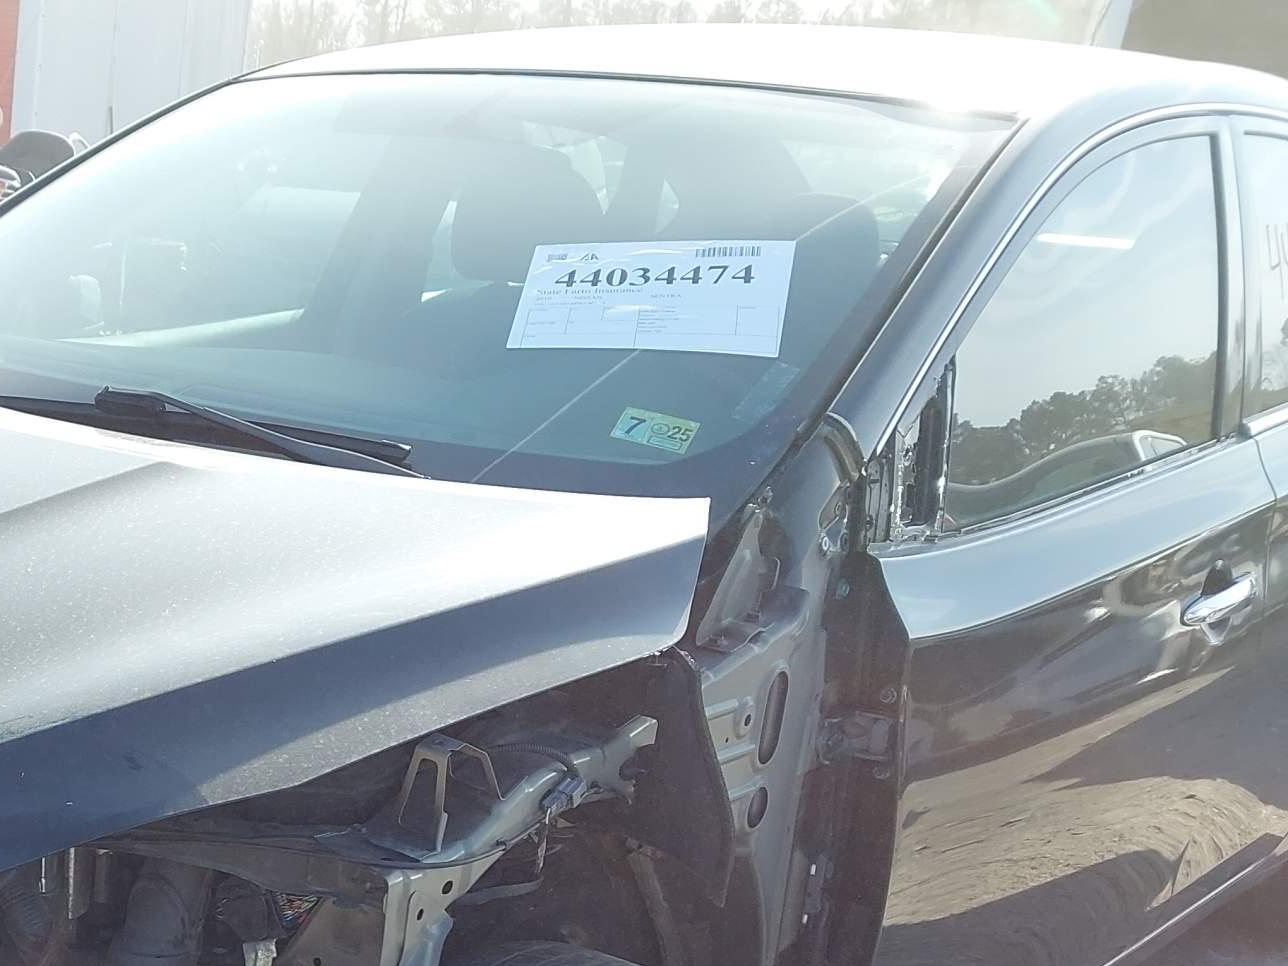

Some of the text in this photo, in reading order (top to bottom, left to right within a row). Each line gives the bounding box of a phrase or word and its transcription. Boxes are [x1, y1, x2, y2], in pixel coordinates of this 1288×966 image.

[554, 264, 755, 288] 44034474
[624, 416, 694, 442] 7 25
